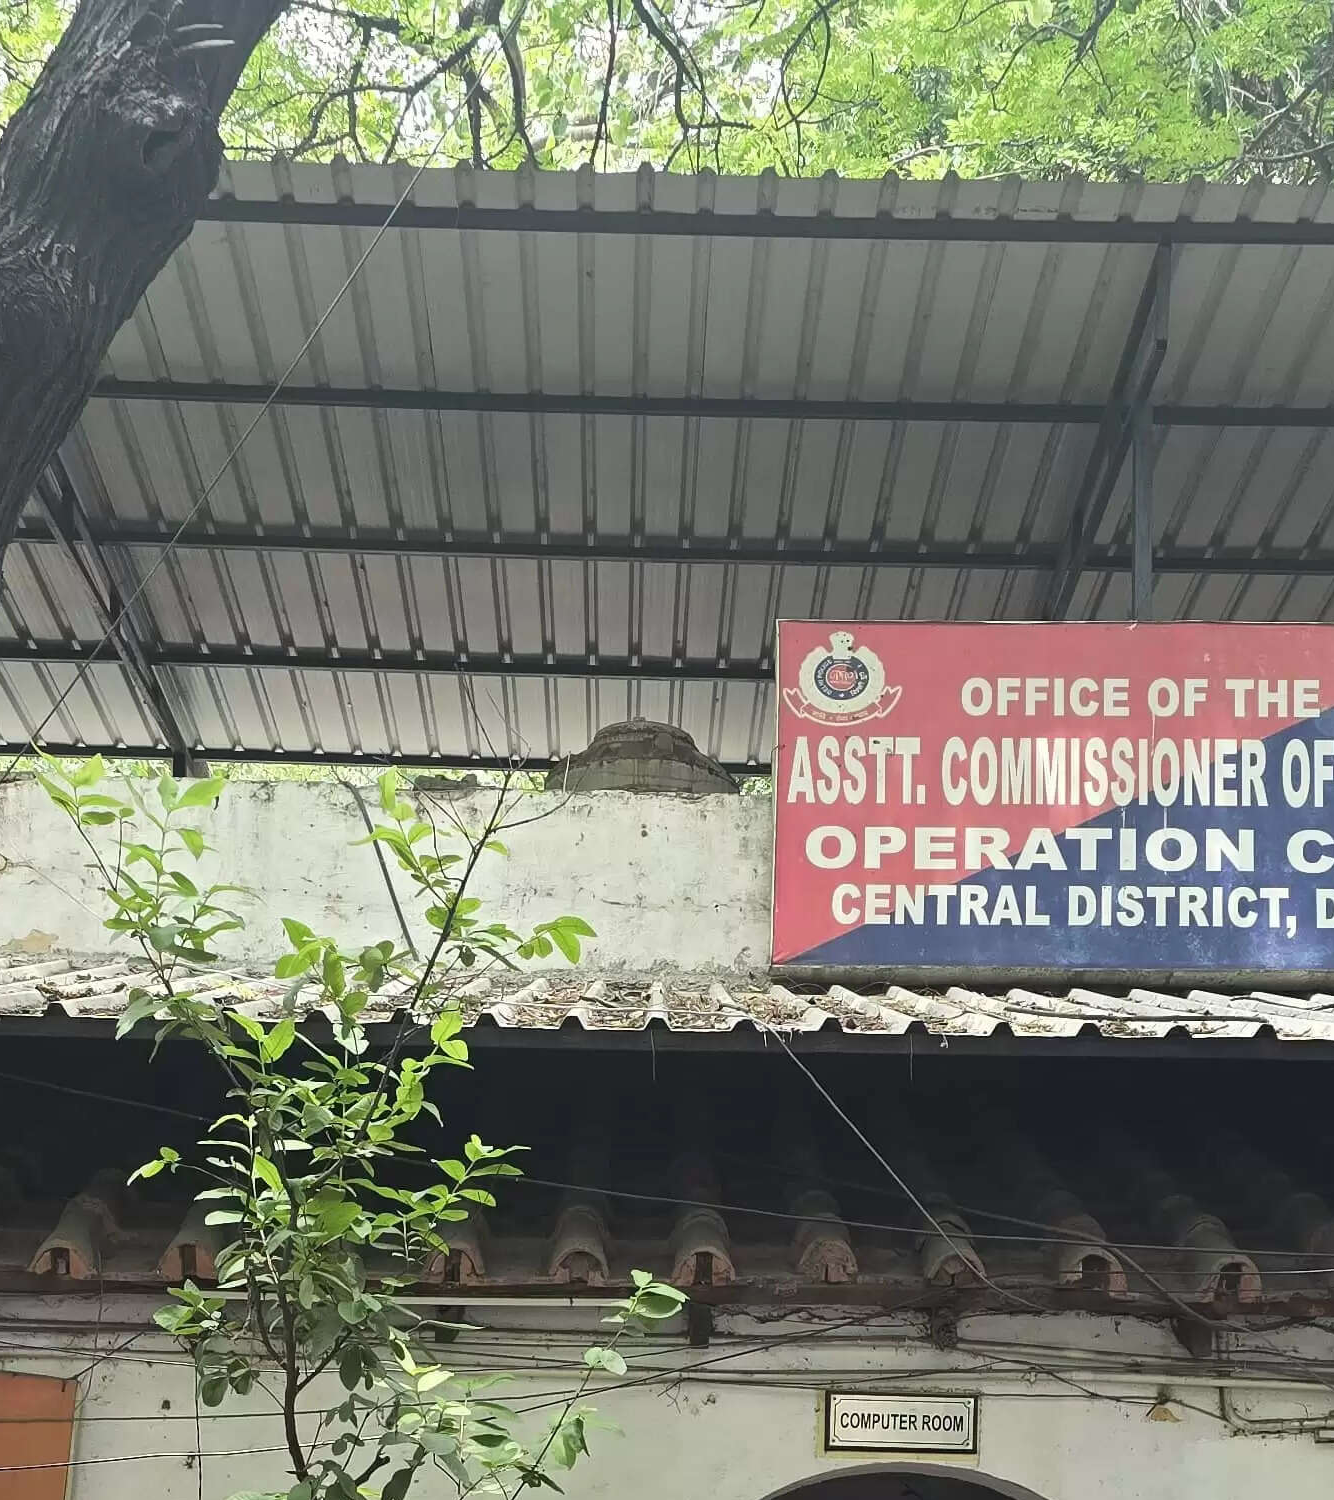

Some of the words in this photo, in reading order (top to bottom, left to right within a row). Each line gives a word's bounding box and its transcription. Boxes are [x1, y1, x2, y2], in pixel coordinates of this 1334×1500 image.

[961, 677, 1130, 717] OFFICE
[1149, 678, 1229, 717] OF
[1239, 678, 1321, 718] THE
[787, 736, 926, 805] ASSTT.
[942, 736, 1269, 808] COMMISSIONER
[805, 826, 1255, 873] OPERATION
[832, 883, 1050, 927] CENTRAL
[1068, 886, 1298, 938] DISTRICT,
[840, 1412, 918, 1431] COMPUTER
[922, 1414, 964, 1432] ROOM
